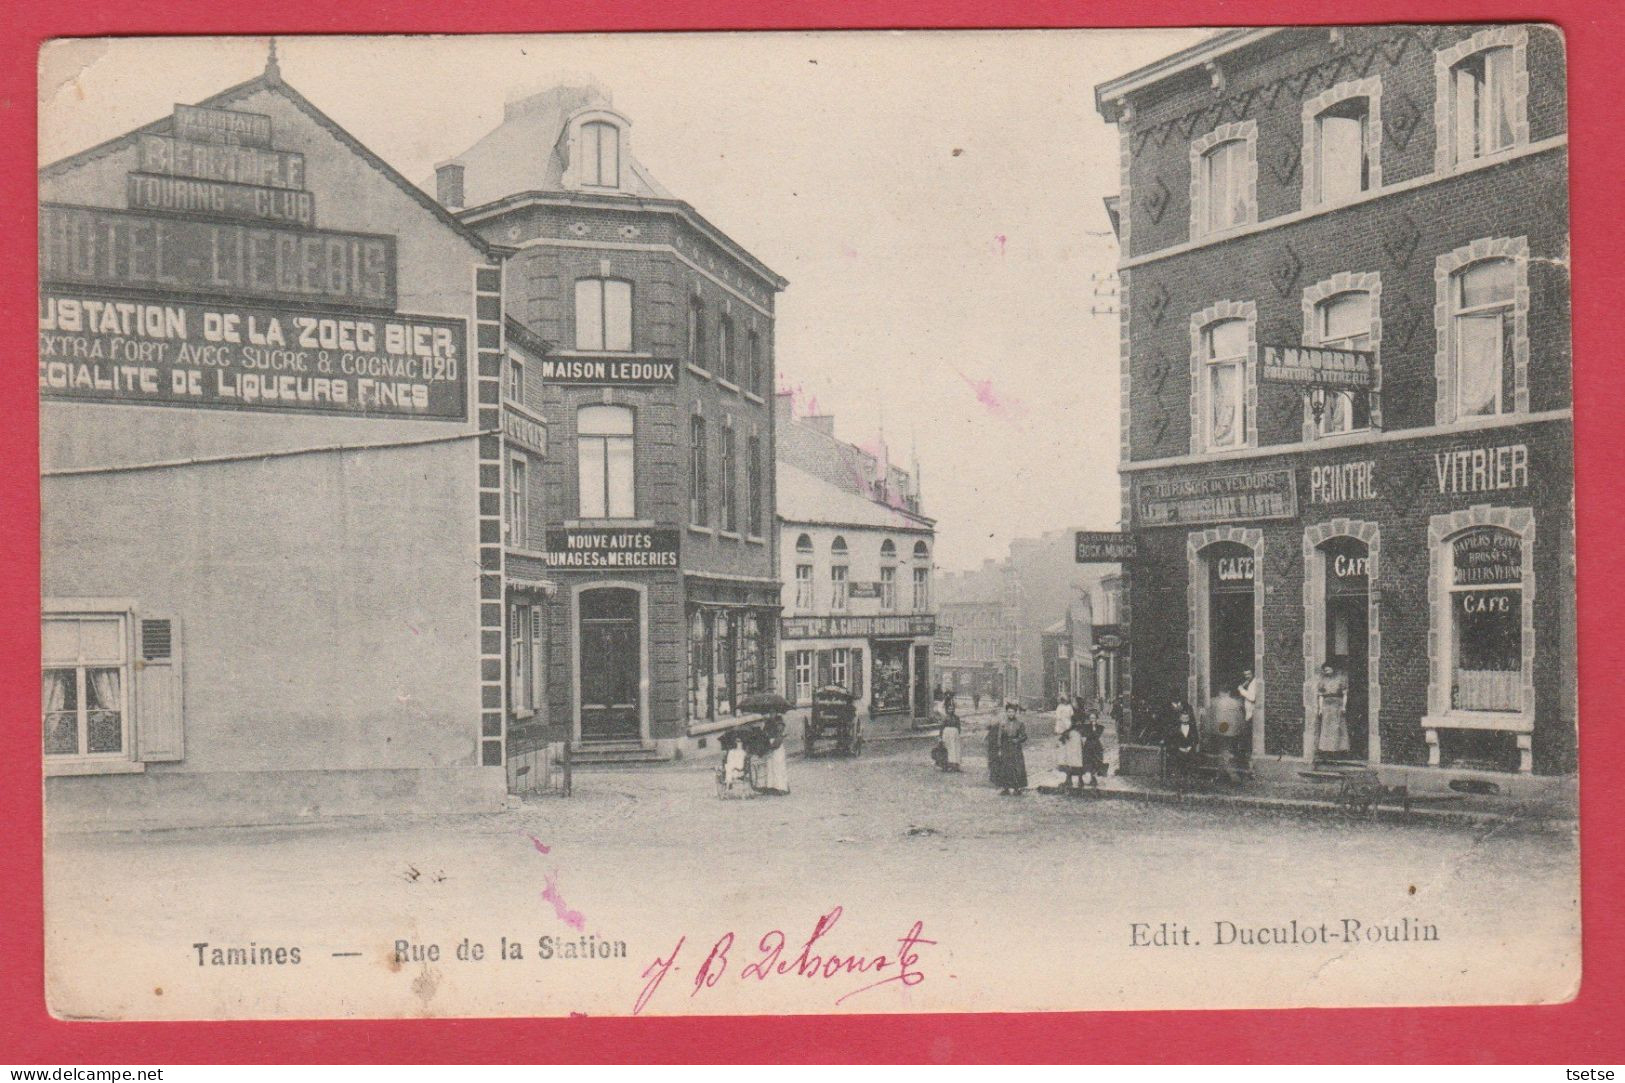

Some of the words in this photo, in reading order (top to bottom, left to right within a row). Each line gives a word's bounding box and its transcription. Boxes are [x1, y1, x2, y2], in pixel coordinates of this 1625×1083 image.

[132, 176, 224, 212] TOURING
[255, 189, 310, 225] CLUB
[204, 312, 241, 343] DE
[248, 315, 286, 347] LA
[109, 337, 168, 363] FORT
[177, 342, 230, 367] AVEC
[242, 346, 308, 372] SUCRE
[317, 350, 333, 375] &
[341, 353, 417, 378] COGNAC
[543, 361, 605, 379] MAISON
[611, 362, 675, 380] LEDOUX
[172, 369, 203, 396] DE
[218, 368, 349, 403] LIQUEURS
[357, 378, 429, 409] FINES
[1311, 460, 1377, 504] PEINTRE
[1434, 443, 1529, 494] VITRIER
[1463, 595, 1510, 613] CAFE
[193, 941, 302, 967] Tamines
[394, 938, 441, 963] Rue
[456, 937, 485, 962] de
[500, 936, 524, 961] la
[538, 934, 628, 960] Station
[1128, 921, 1200, 947] Edit.
[1213, 916, 1441, 947] Duculot-Roulin
